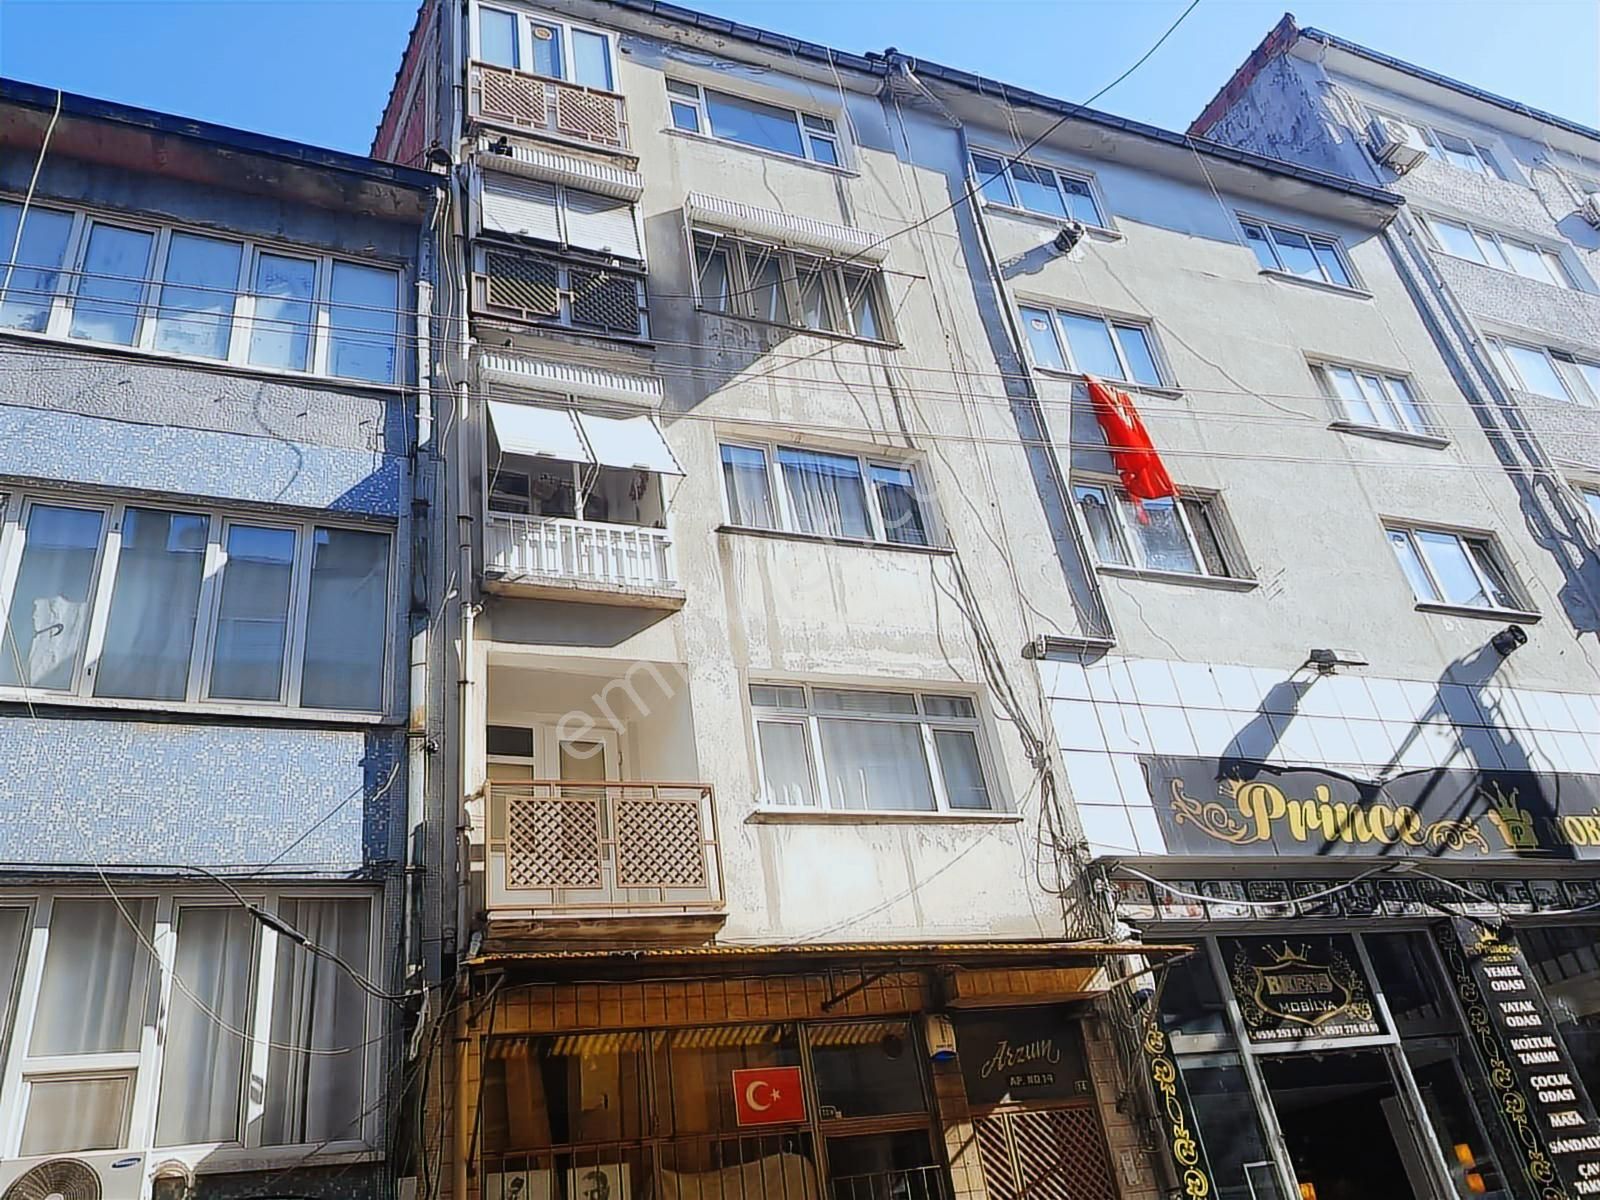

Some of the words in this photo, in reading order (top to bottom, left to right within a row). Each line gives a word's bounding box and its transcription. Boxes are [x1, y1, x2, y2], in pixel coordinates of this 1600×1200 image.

[1237, 783, 1422, 846] Prince
[1483, 966, 1522, 978] YEMEK
[1491, 980, 1526, 991] ODASI
[1279, 998, 1337, 1013] MOBİLYA
[1500, 1001, 1536, 1013] YATAK
[1506, 1015, 1542, 1027] ODASI
[1511, 1036, 1556, 1050] KOLTUK
[982, 1040, 1060, 1078] Arzum
[1518, 1051, 1560, 1064] TAKIMI
[1530, 1074, 1572, 1091] ÇOCUK
[1538, 1089, 1576, 1103] ODASI
[1547, 1111, 1586, 1128] MASA
